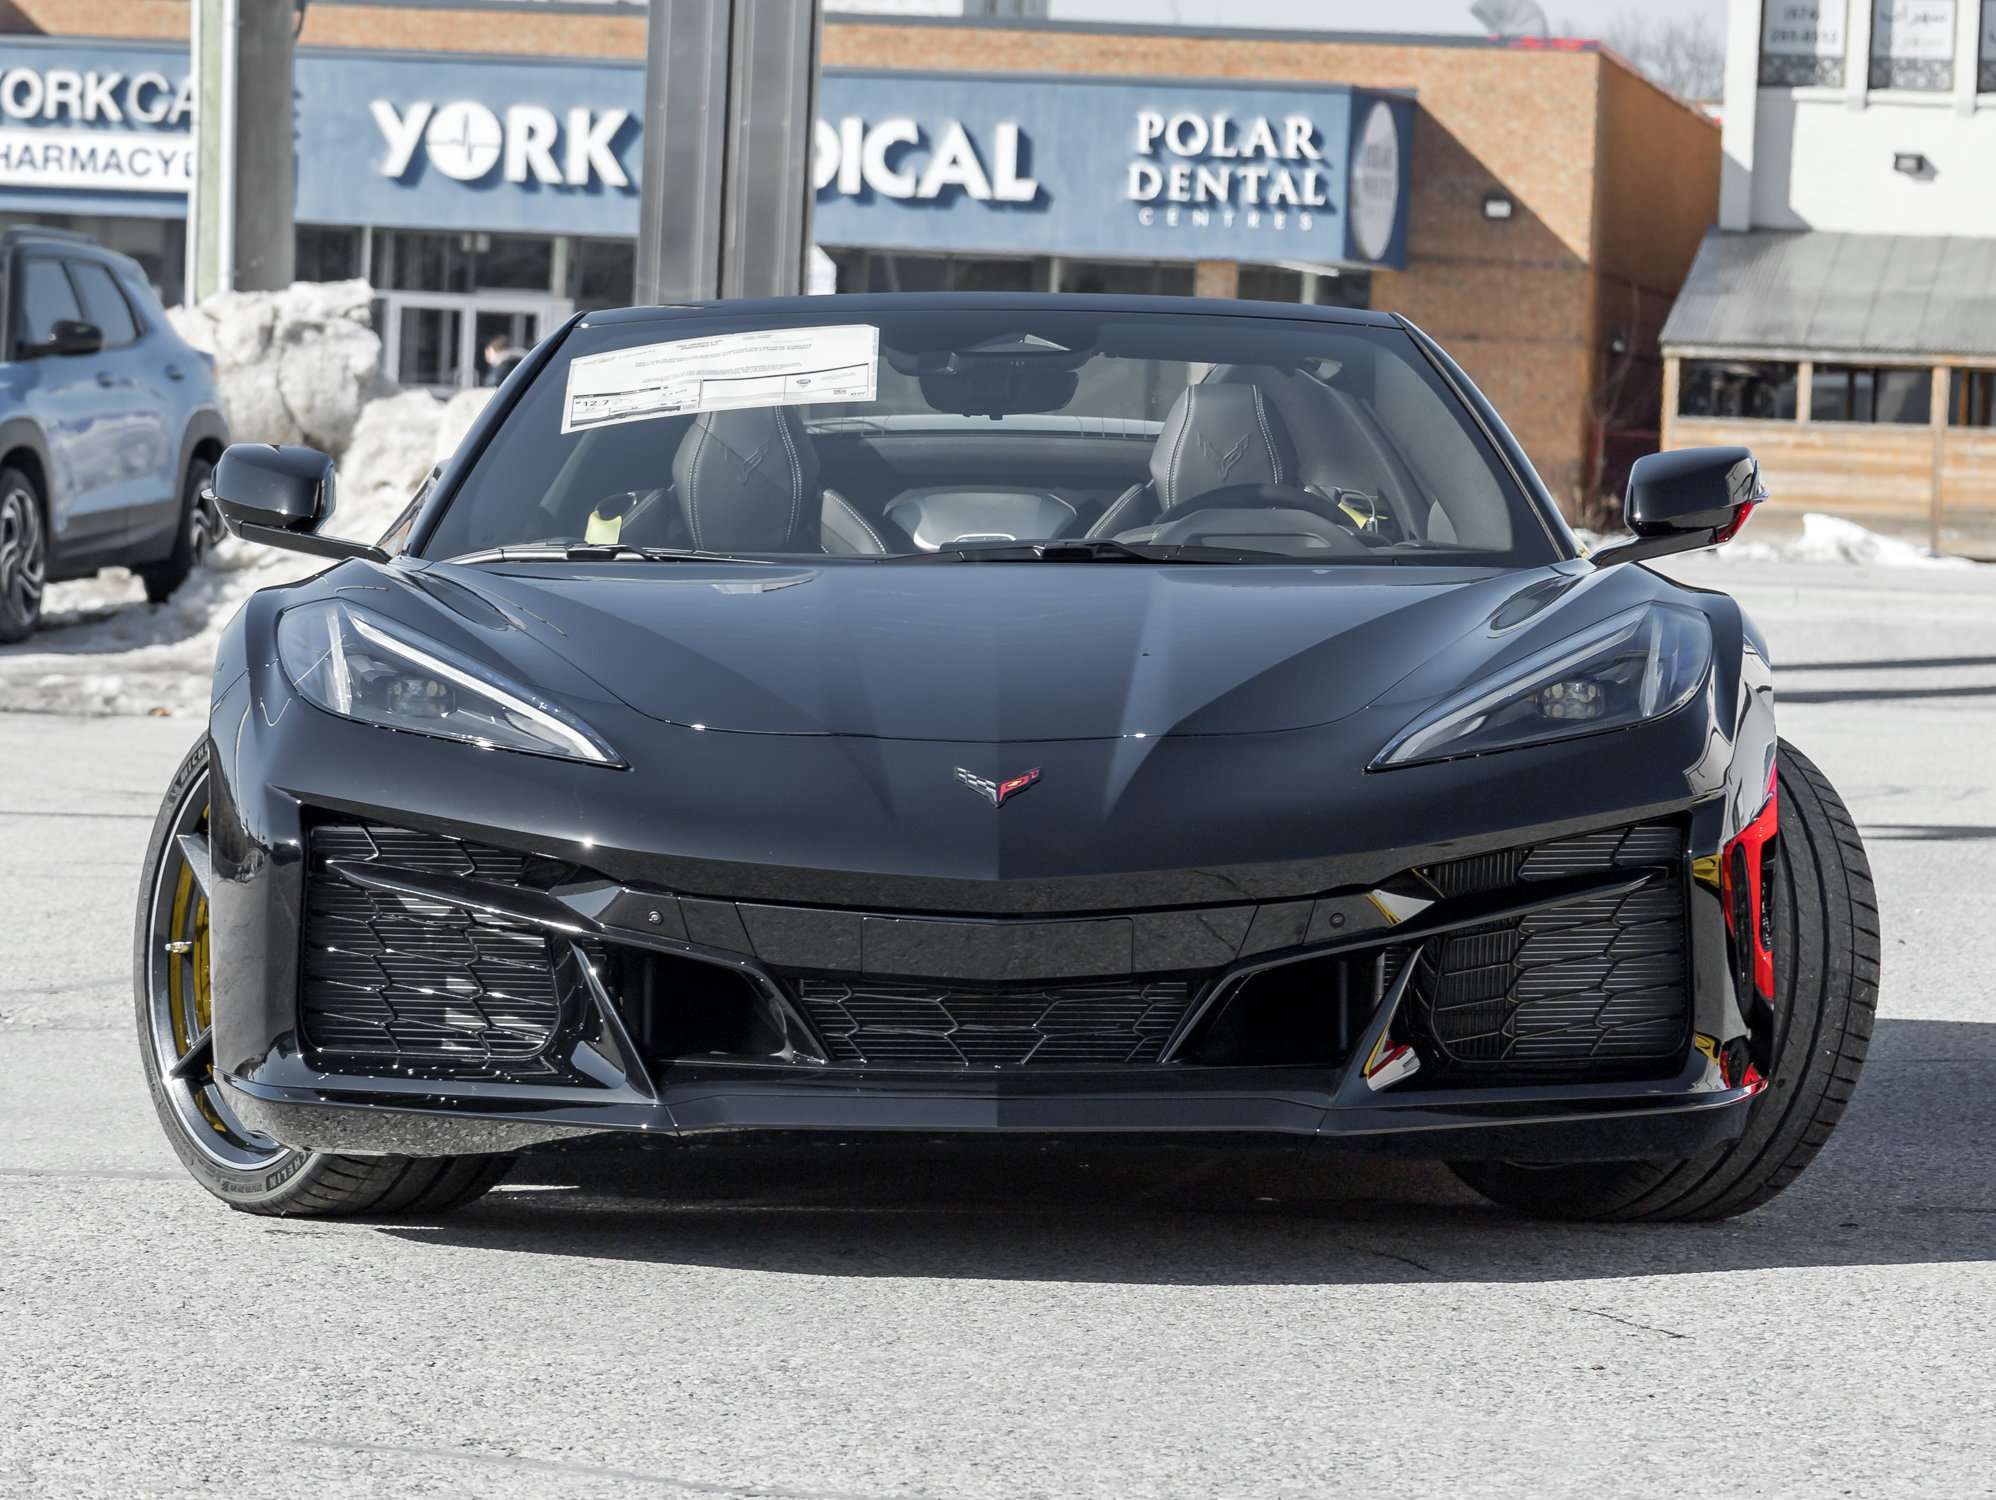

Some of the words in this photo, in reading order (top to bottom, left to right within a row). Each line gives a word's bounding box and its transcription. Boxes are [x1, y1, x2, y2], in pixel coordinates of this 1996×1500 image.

[371, 99, 629, 188] YORK
[814, 115, 1038, 202] DICAL
[1138, 111, 1321, 160] POLAR
[0, 143, 177, 177] HARMACY
[1128, 161, 1327, 206] DENTAL
[1138, 207, 1313, 231] CENTRES
[270, 1151, 307, 1188] CHELIN
